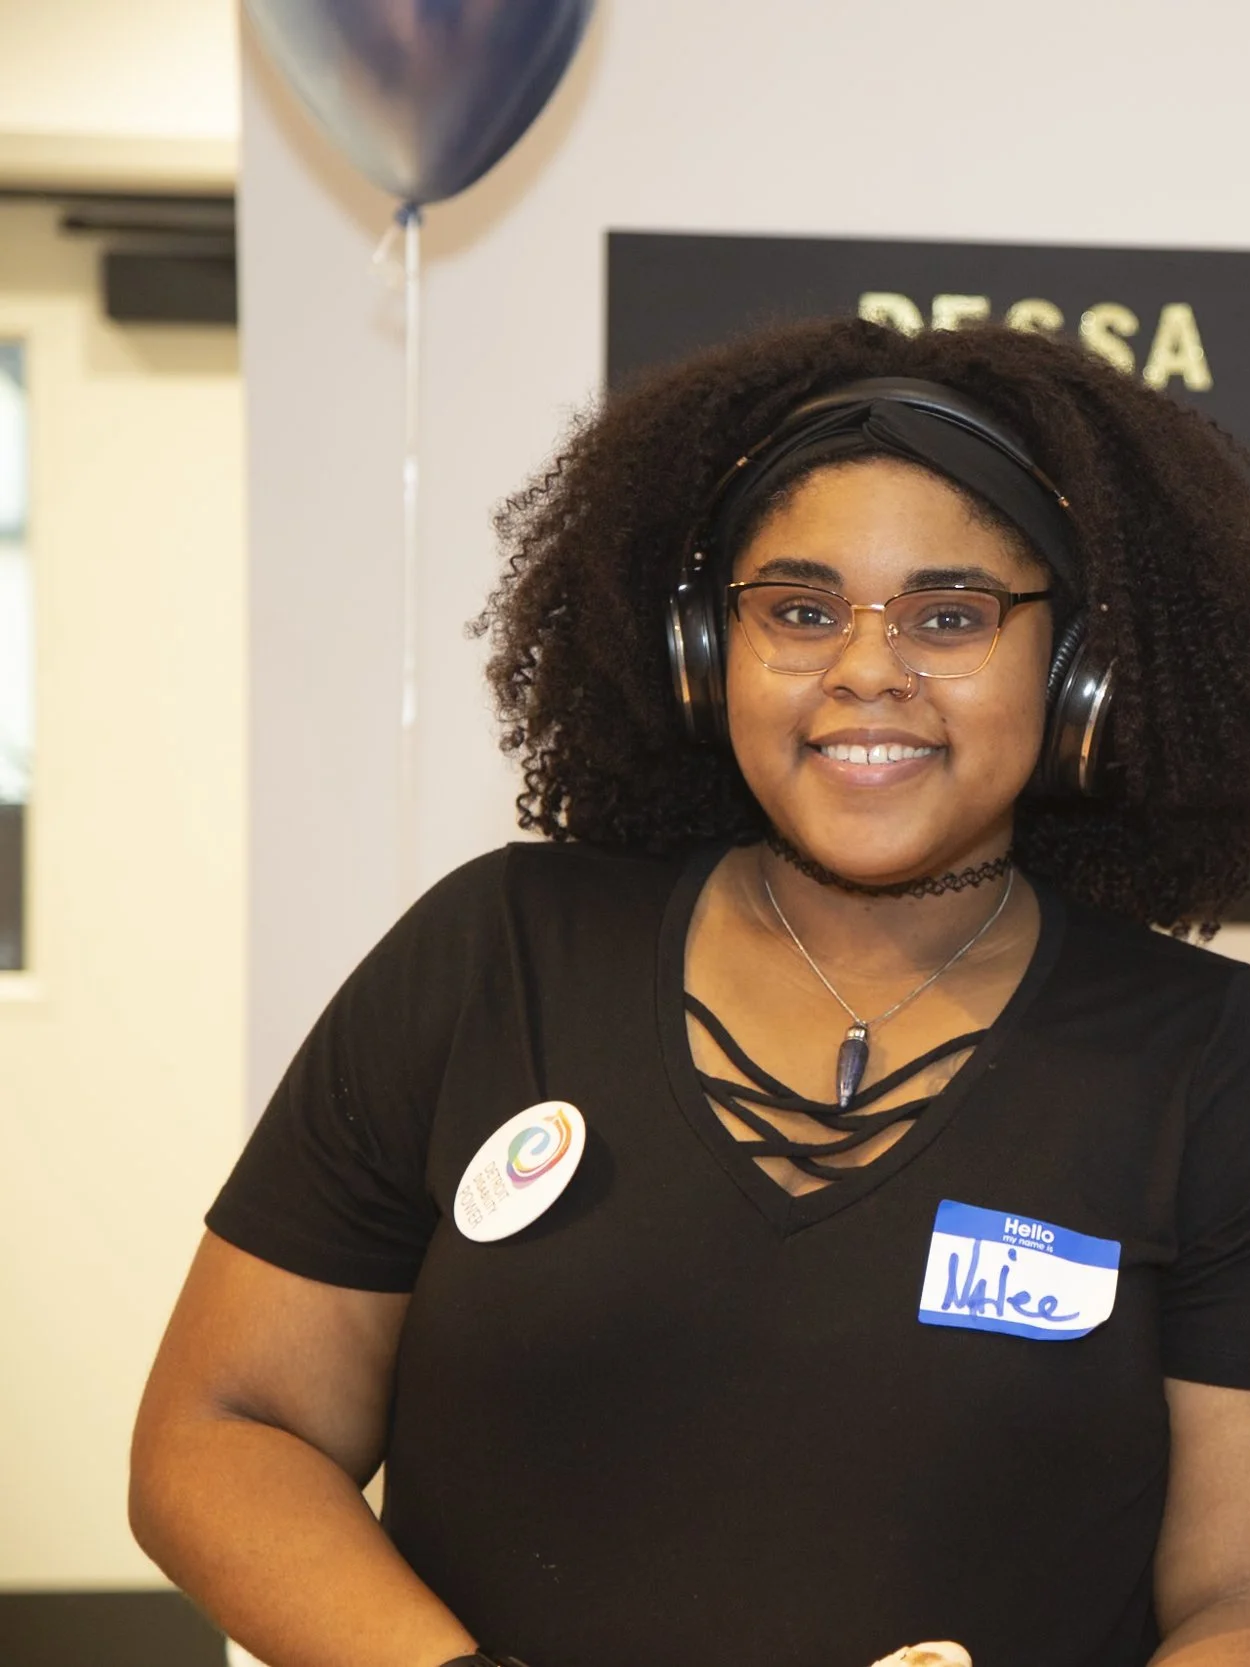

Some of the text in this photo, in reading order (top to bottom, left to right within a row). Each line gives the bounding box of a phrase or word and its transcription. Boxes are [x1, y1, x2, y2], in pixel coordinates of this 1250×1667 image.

[484, 1160, 510, 1203] DETROIT
[458, 1185, 484, 1230] POWER
[1002, 1234, 1018, 1245] my
[1018, 1237, 1046, 1251] name
[1004, 1216, 1055, 1243] Hello
